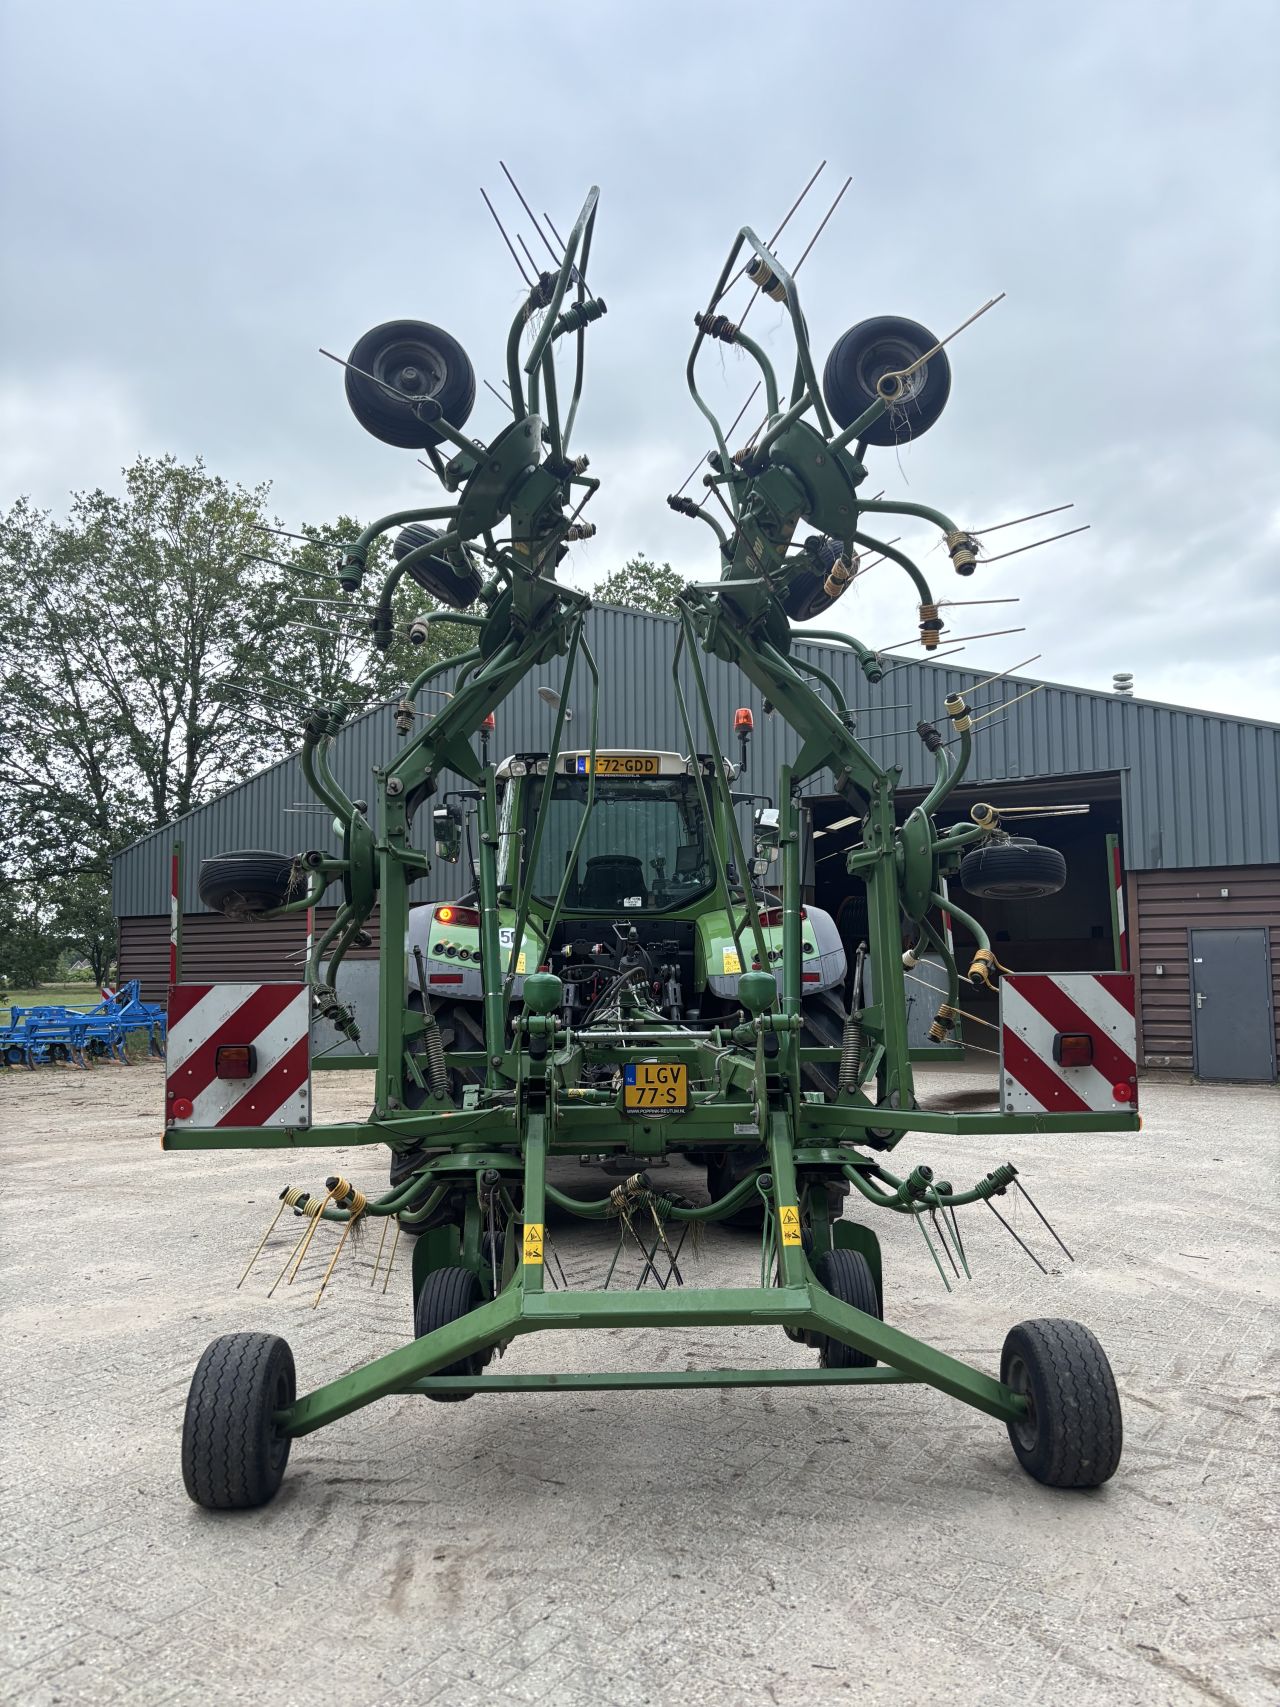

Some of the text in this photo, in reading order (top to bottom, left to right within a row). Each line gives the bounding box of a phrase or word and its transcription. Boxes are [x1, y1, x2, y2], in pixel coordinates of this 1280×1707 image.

[595, 759, 654, 772] -72-GDD
[644, 1067, 681, 1084] LGV
[636, 1087, 677, 1104] 77-S
